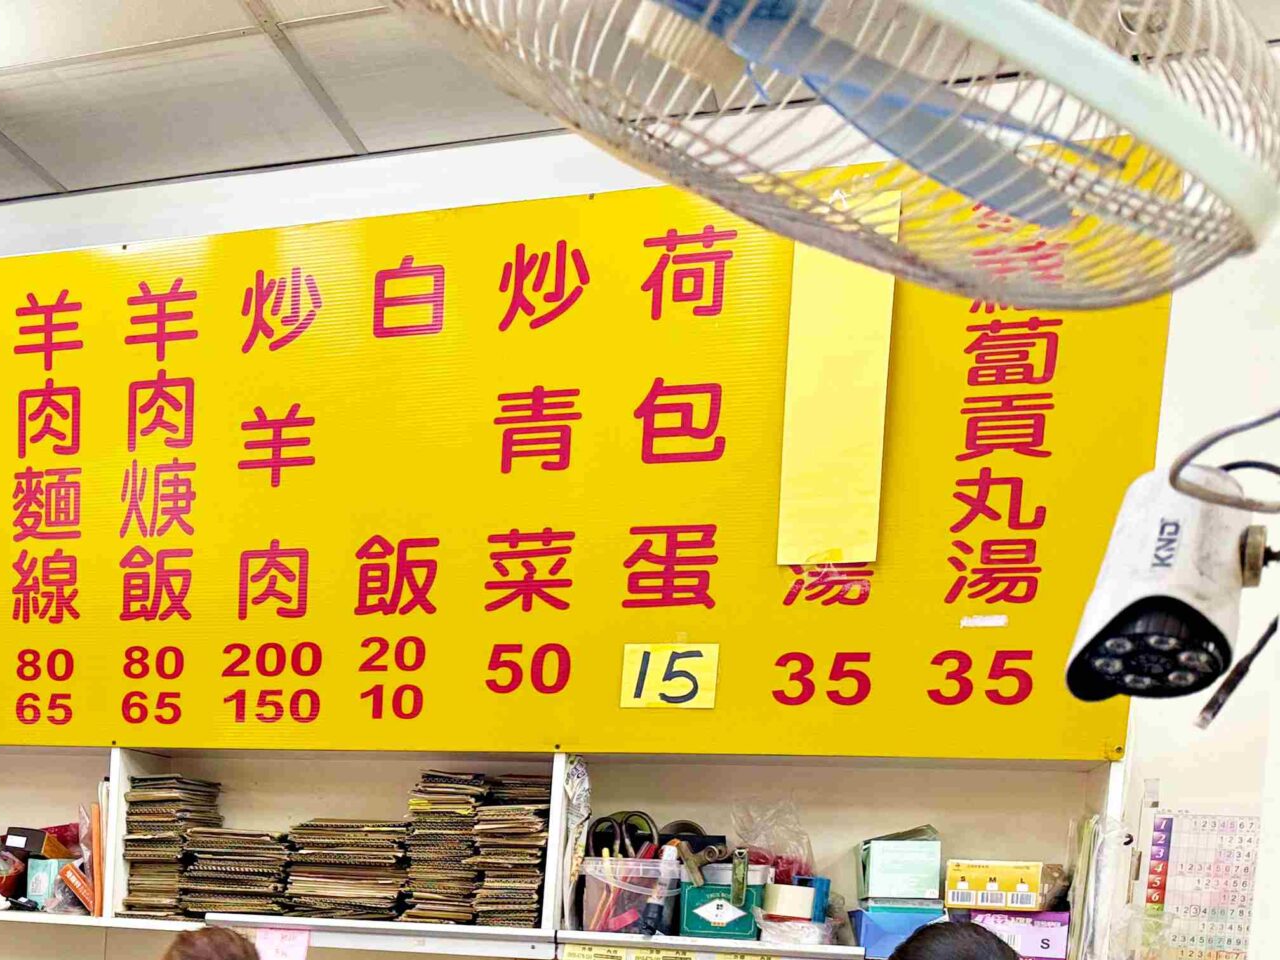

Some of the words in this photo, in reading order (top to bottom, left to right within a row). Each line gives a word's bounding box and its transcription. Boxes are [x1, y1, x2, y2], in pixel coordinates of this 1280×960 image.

[356, 257, 444, 614] 白飯
[486, 241, 589, 611] 炒青菜
[623, 226, 736, 608] 荷包蛋
[14, 291, 82, 623] 羊肉麵線
[239, 272, 321, 619] 炒羊肉
[17, 649, 73, 680] 80
[124, 647, 183, 679] 80
[223, 643, 321, 676] 200
[361, 637, 425, 670] 20
[487, 644, 570, 693] 50
[634, 651, 702, 703] 15
[774, 653, 870, 705] 35
[929, 651, 1032, 704] 35
[17, 694, 72, 724] 65
[123, 692, 180, 724] 65
[225, 690, 319, 722] 150
[362, 685, 422, 718] 10
[1040, 938, 1051, 950] S
